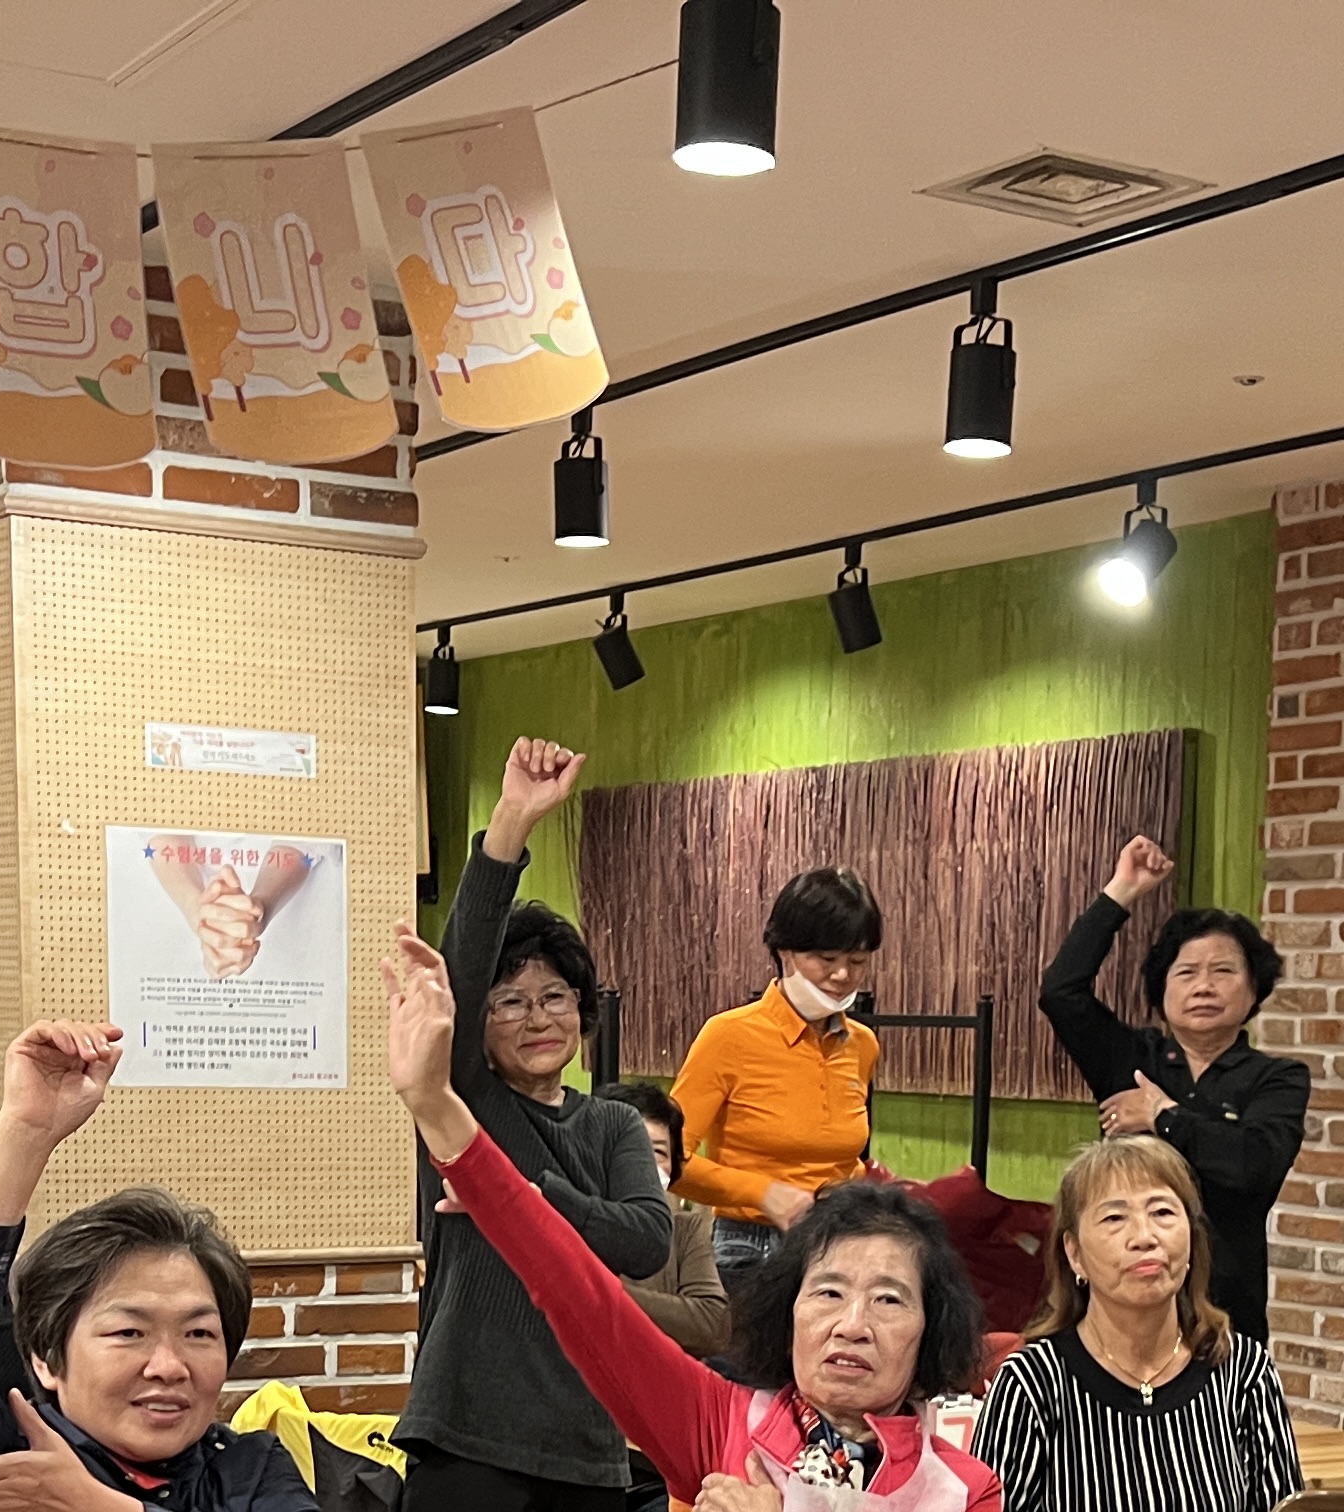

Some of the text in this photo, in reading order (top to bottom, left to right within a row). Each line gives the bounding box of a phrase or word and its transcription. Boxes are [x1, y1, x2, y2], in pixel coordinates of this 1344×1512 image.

[160, 844, 297, 868] 수험생을 위한 기도
